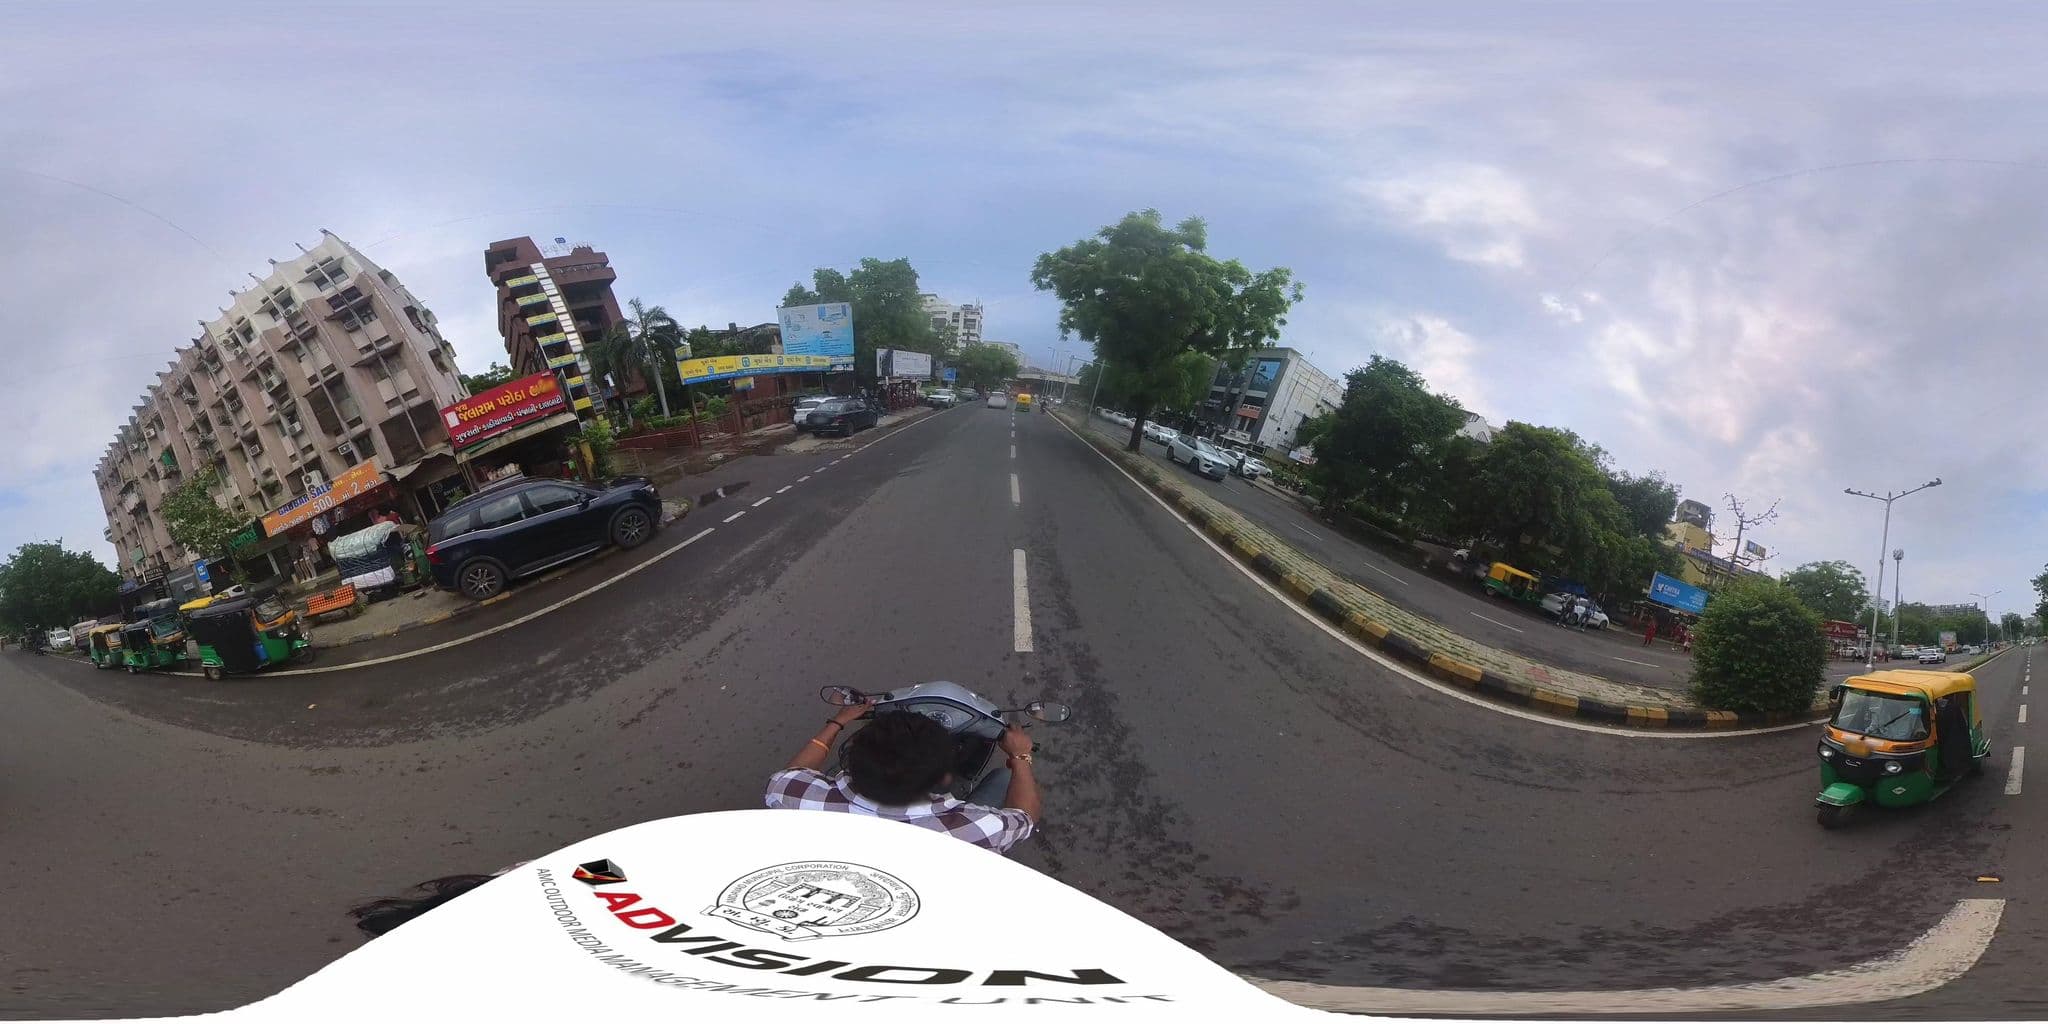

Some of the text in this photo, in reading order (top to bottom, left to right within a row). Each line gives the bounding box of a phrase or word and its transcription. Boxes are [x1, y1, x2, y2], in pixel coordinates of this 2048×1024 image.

[458, 401, 495, 422] જલારામ
[497, 389, 526, 407] પરોઠા
[456, 426, 480, 443] ગુજરાતી
[312, 483, 332, 499] SALE
[351, 481, 360, 495] 2
